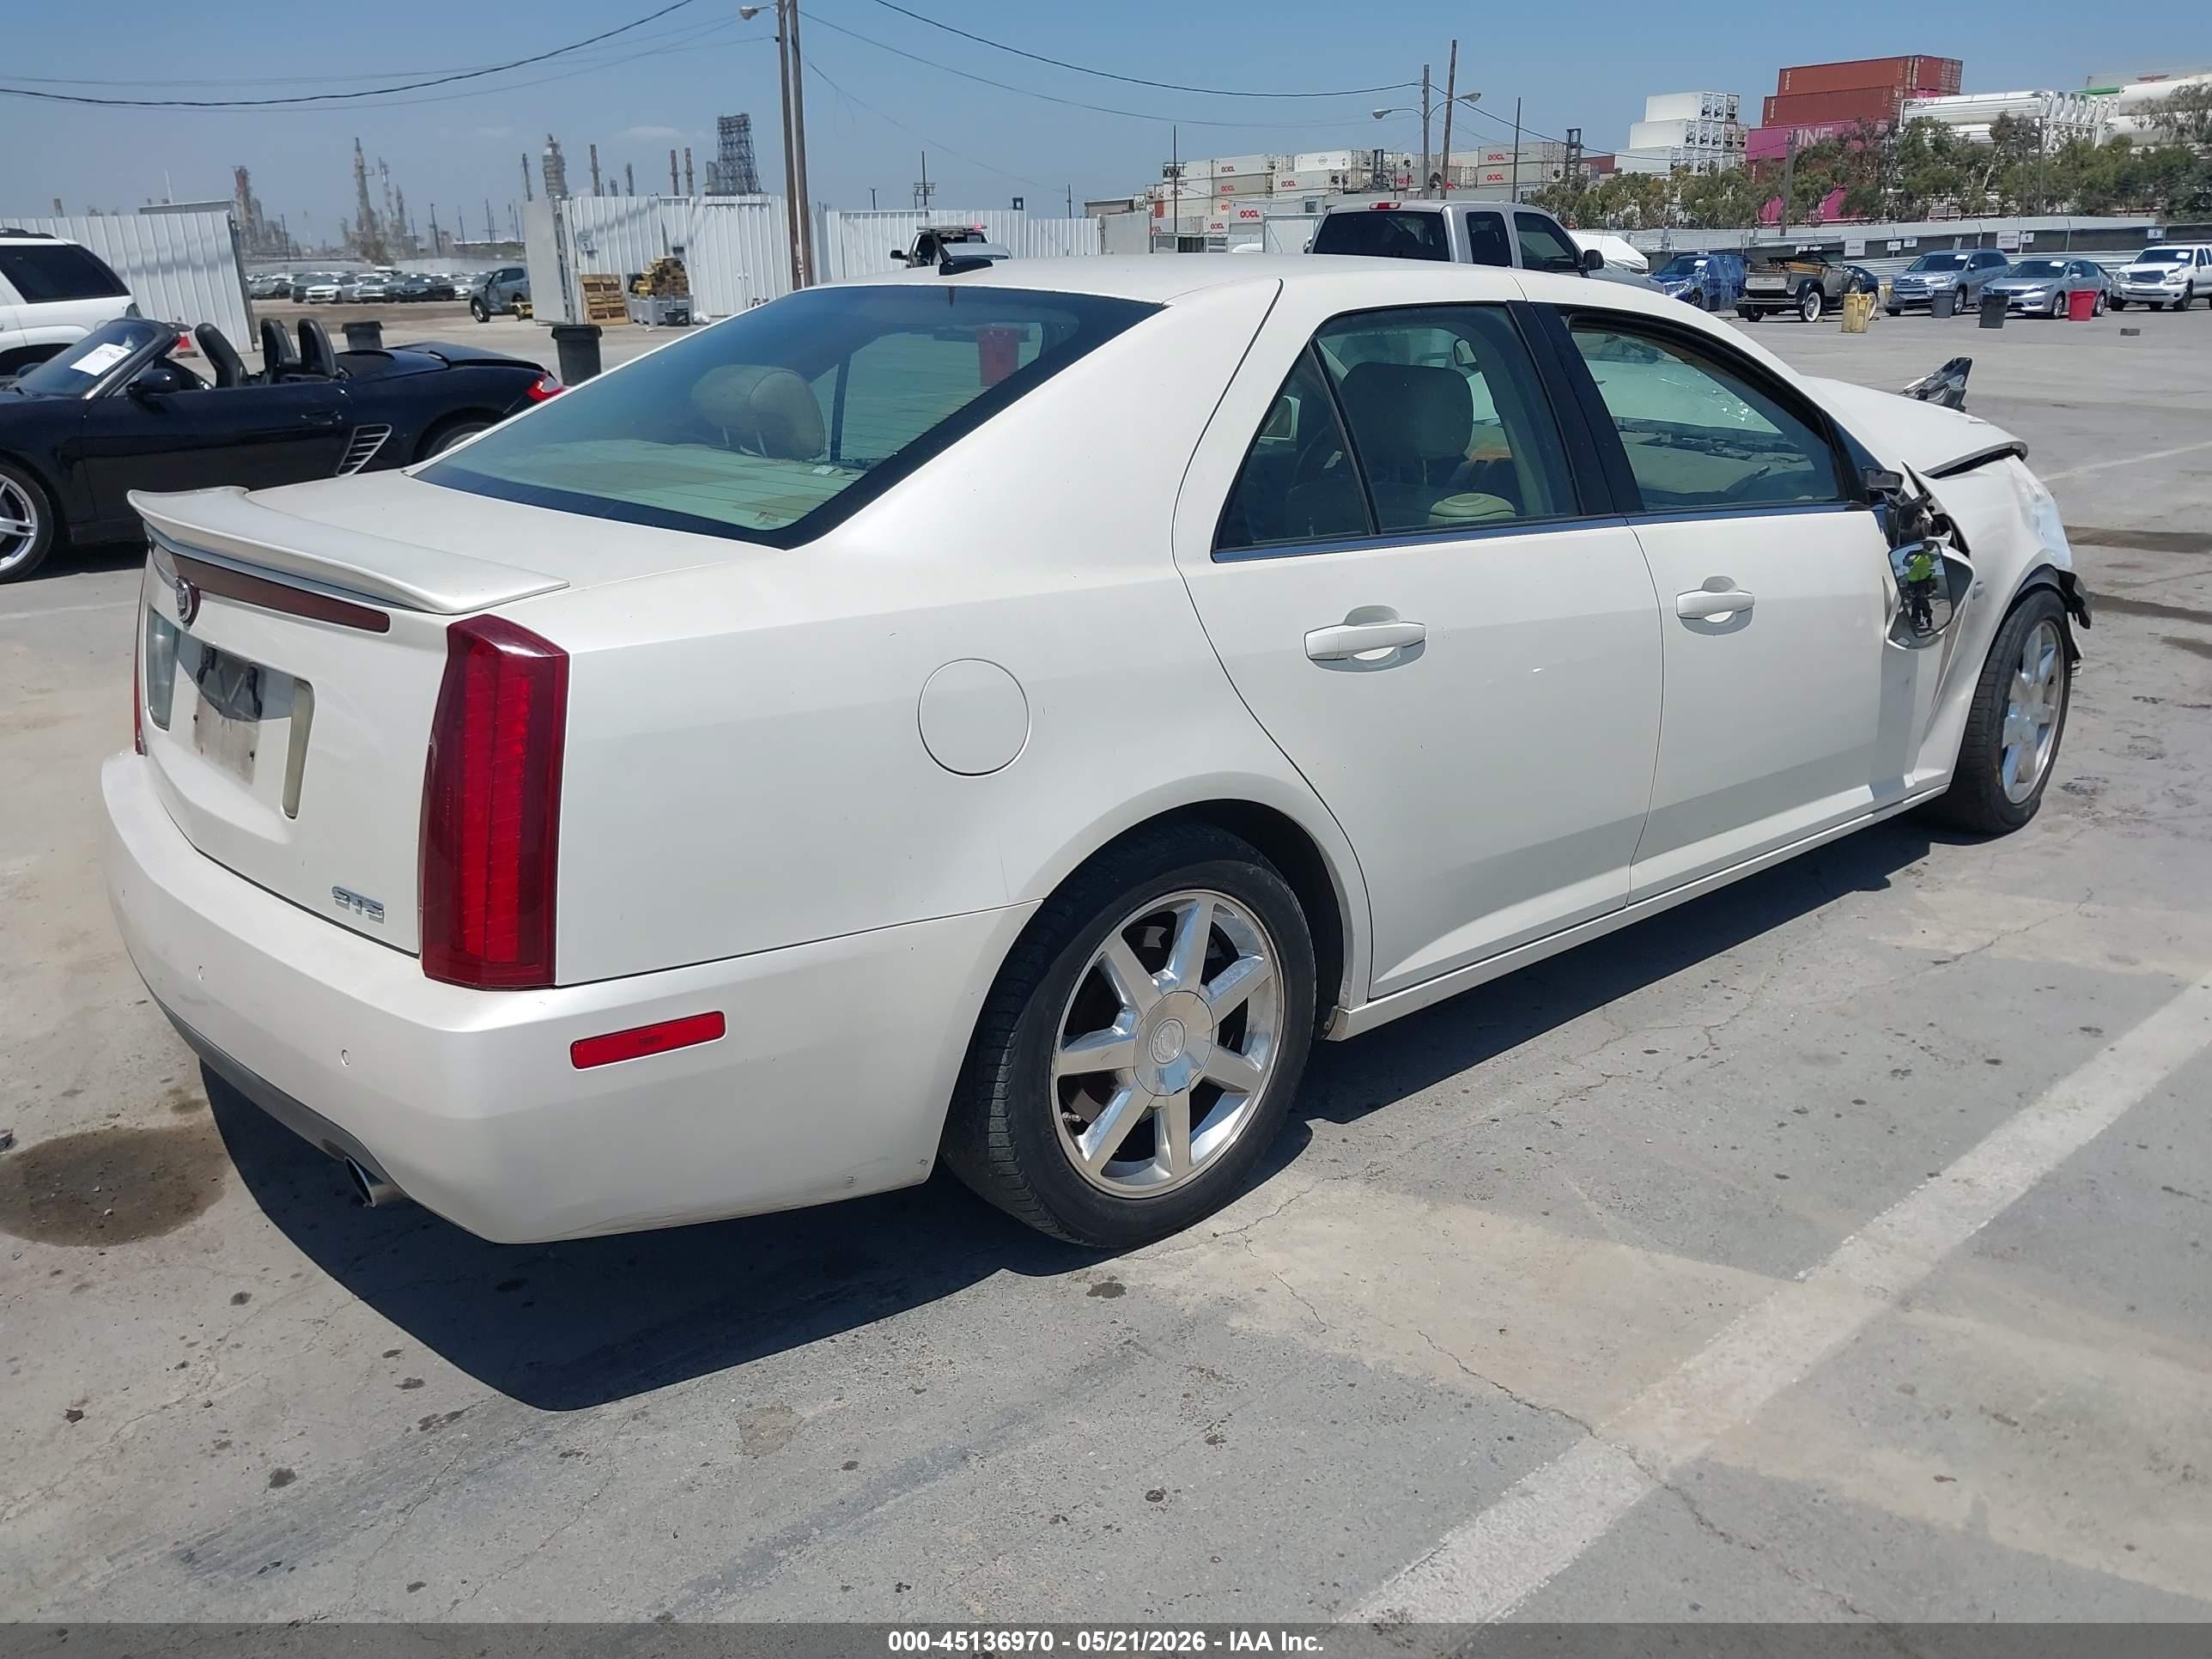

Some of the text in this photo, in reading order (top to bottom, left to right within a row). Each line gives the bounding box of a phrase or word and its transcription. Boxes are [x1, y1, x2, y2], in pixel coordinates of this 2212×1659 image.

[1221, 165, 1236, 173] OOCL
[1280, 179, 1297, 188] OOCL
[1240, 210, 1260, 218] OOCL
[331, 885, 384, 918] STS
